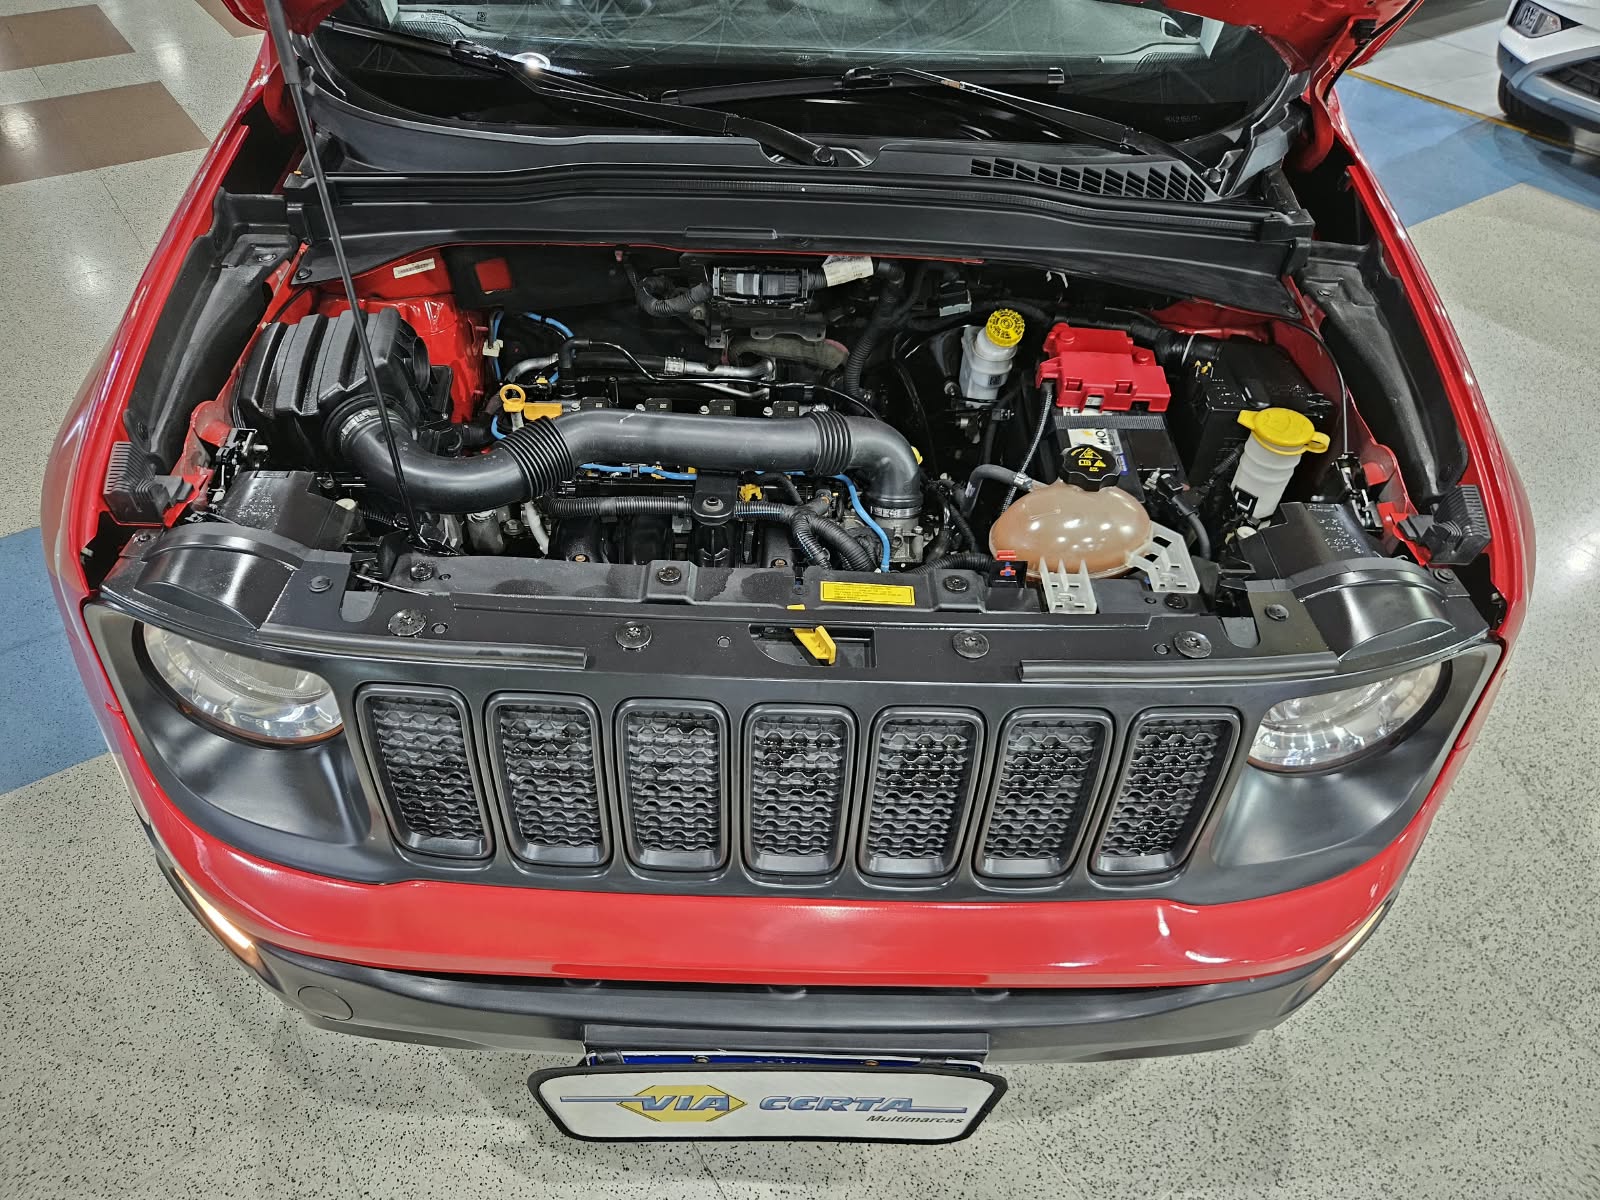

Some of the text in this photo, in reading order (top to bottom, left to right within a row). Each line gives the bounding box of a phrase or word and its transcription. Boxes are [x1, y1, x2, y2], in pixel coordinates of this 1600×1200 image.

[641, 1095, 914, 1113] VIA CERTA
[866, 1114, 965, 1124] Multimarcas
